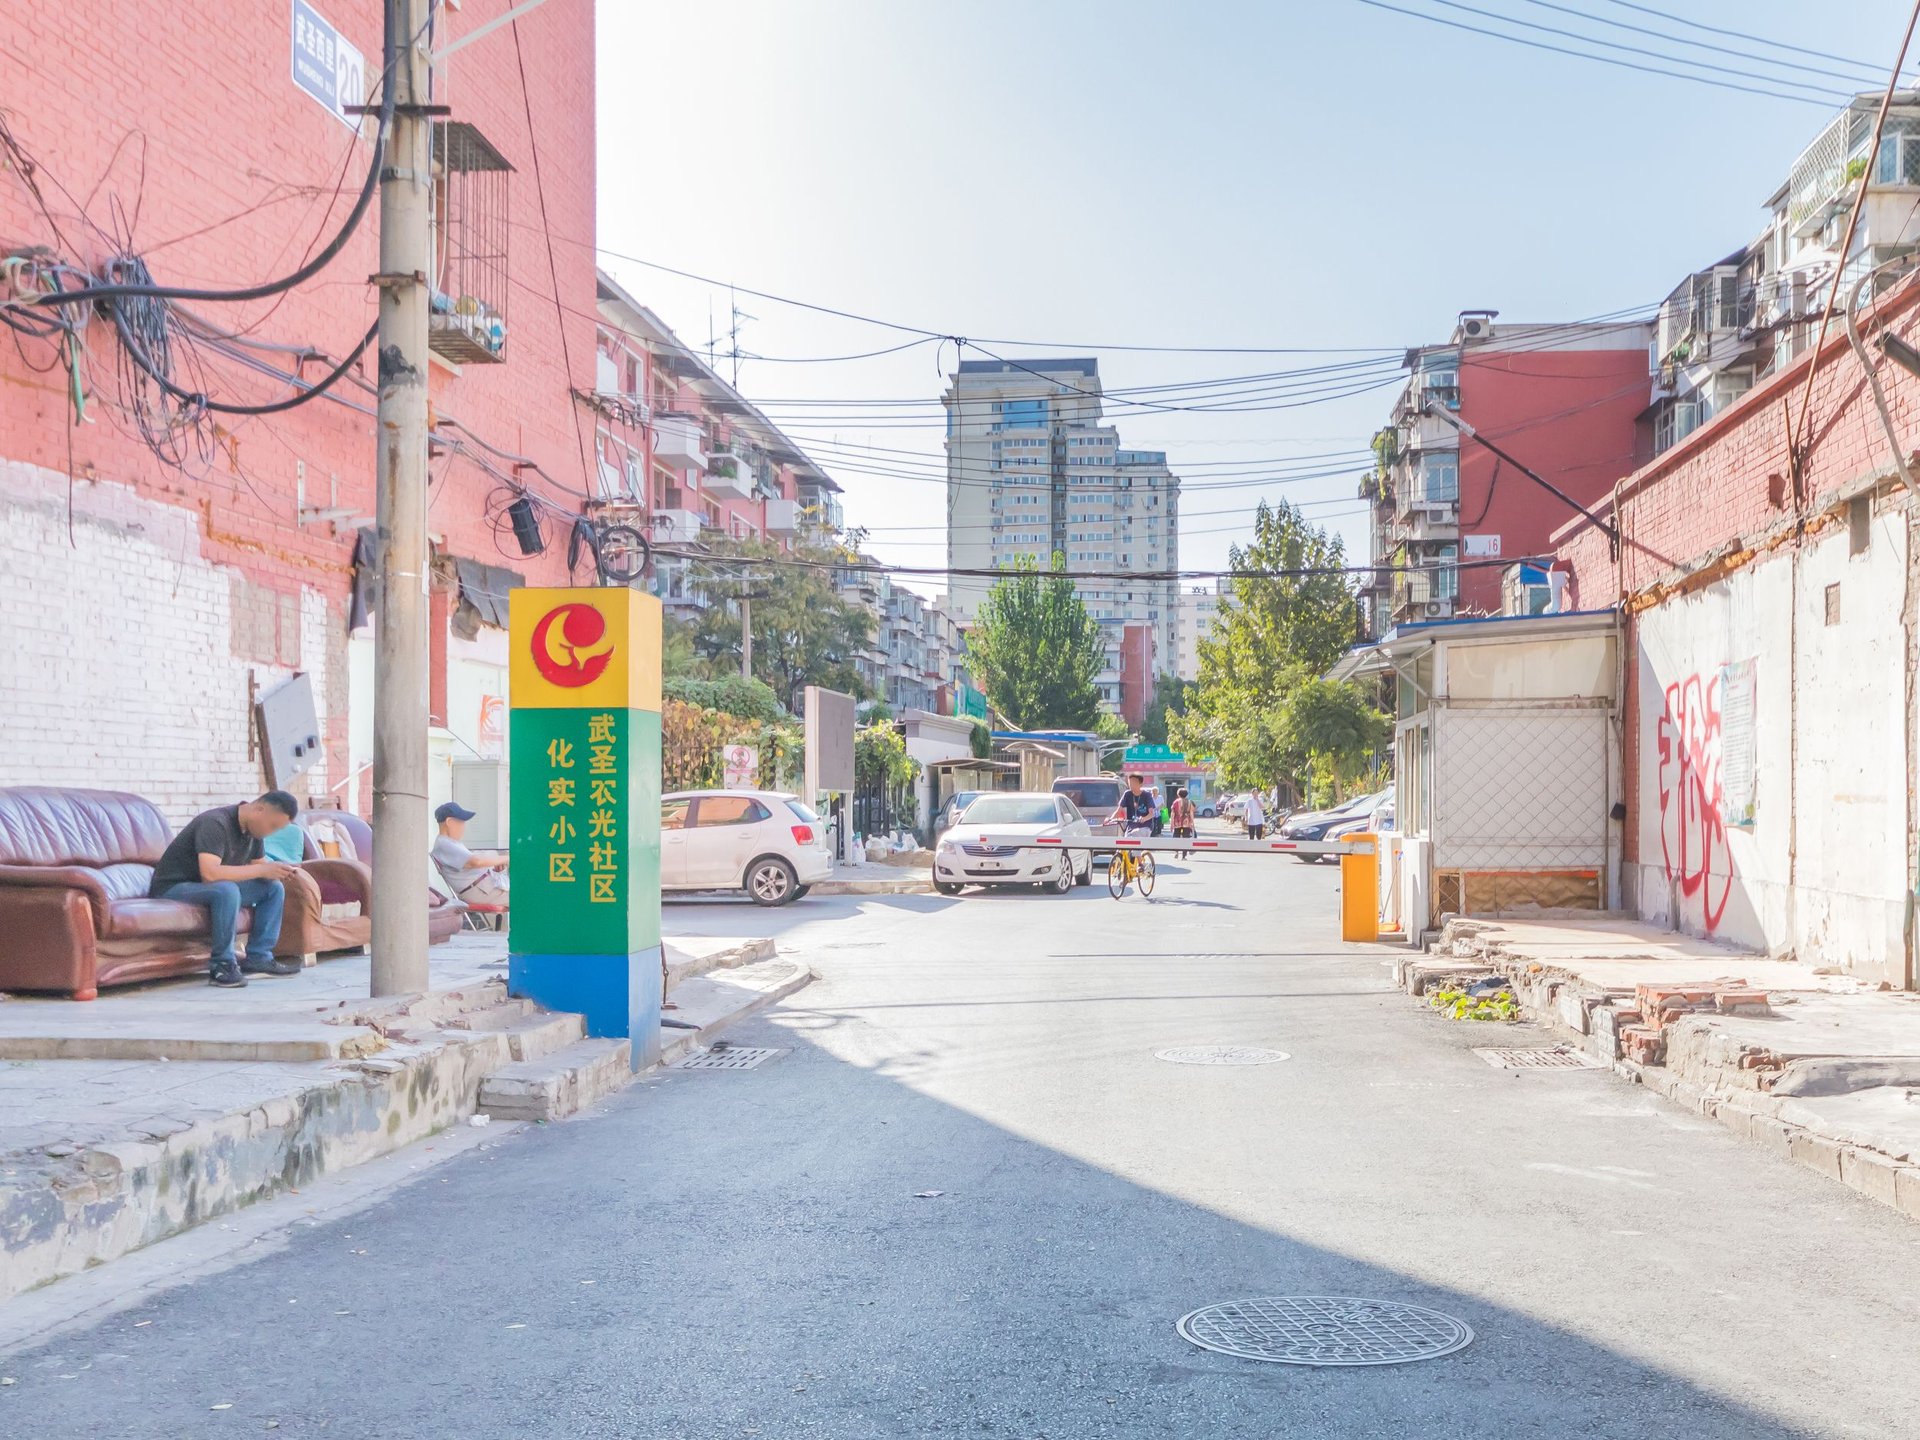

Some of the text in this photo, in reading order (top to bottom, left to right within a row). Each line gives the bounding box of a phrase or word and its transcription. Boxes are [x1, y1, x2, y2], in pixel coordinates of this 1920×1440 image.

[296, 13, 335, 74] 武圣西里
[340, 53, 360, 106] 20
[547, 738, 576, 882] 化实小区
[588, 713, 617, 903] 武圣农光社区
